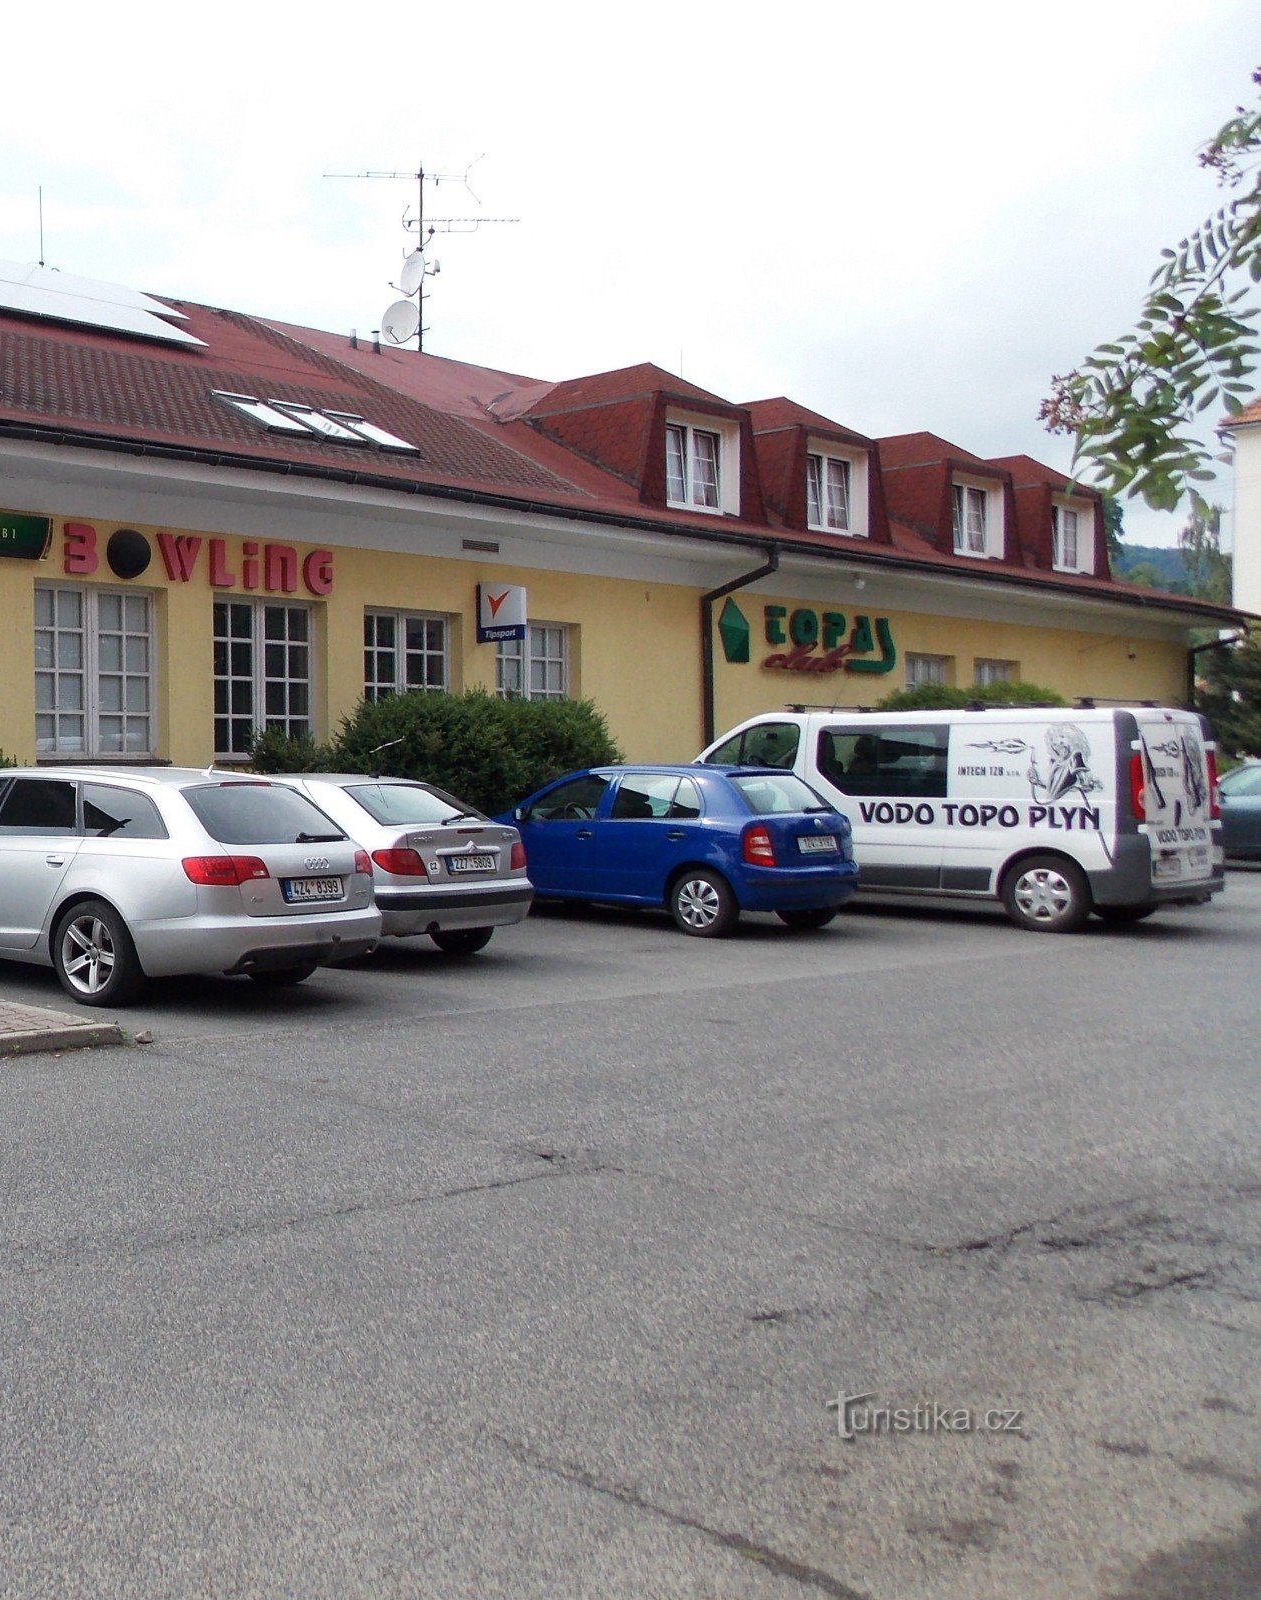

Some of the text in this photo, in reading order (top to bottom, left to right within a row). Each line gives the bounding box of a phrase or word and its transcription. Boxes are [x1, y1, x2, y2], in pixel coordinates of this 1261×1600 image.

[485, 629, 516, 639] Tipsport
[957, 766, 986, 776] INTECH
[859, 802, 1100, 831] VODO TOPO PLYN
[293, 880, 311, 896] 4Z4
[316, 878, 339, 894] 8399
